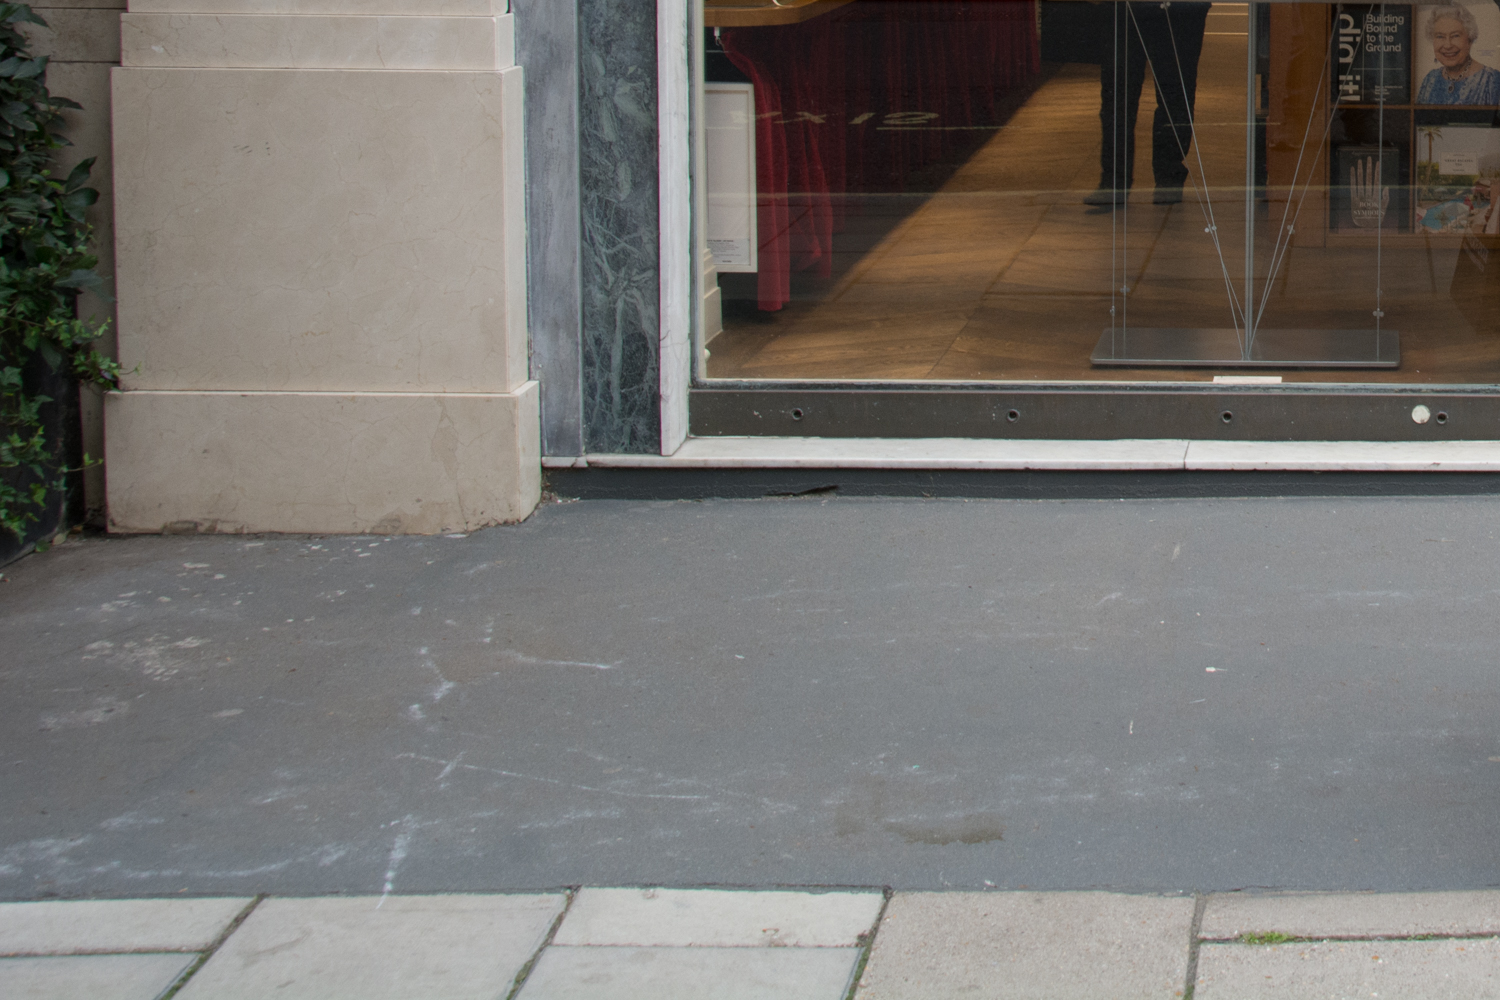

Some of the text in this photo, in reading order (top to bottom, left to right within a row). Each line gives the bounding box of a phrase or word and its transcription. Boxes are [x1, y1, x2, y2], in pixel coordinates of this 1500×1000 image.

[1366, 13, 1404, 25] Building
[1366, 24, 1397, 33] Bound
[1378, 34, 1394, 42] the
[1365, 43, 1401, 52] Ground
